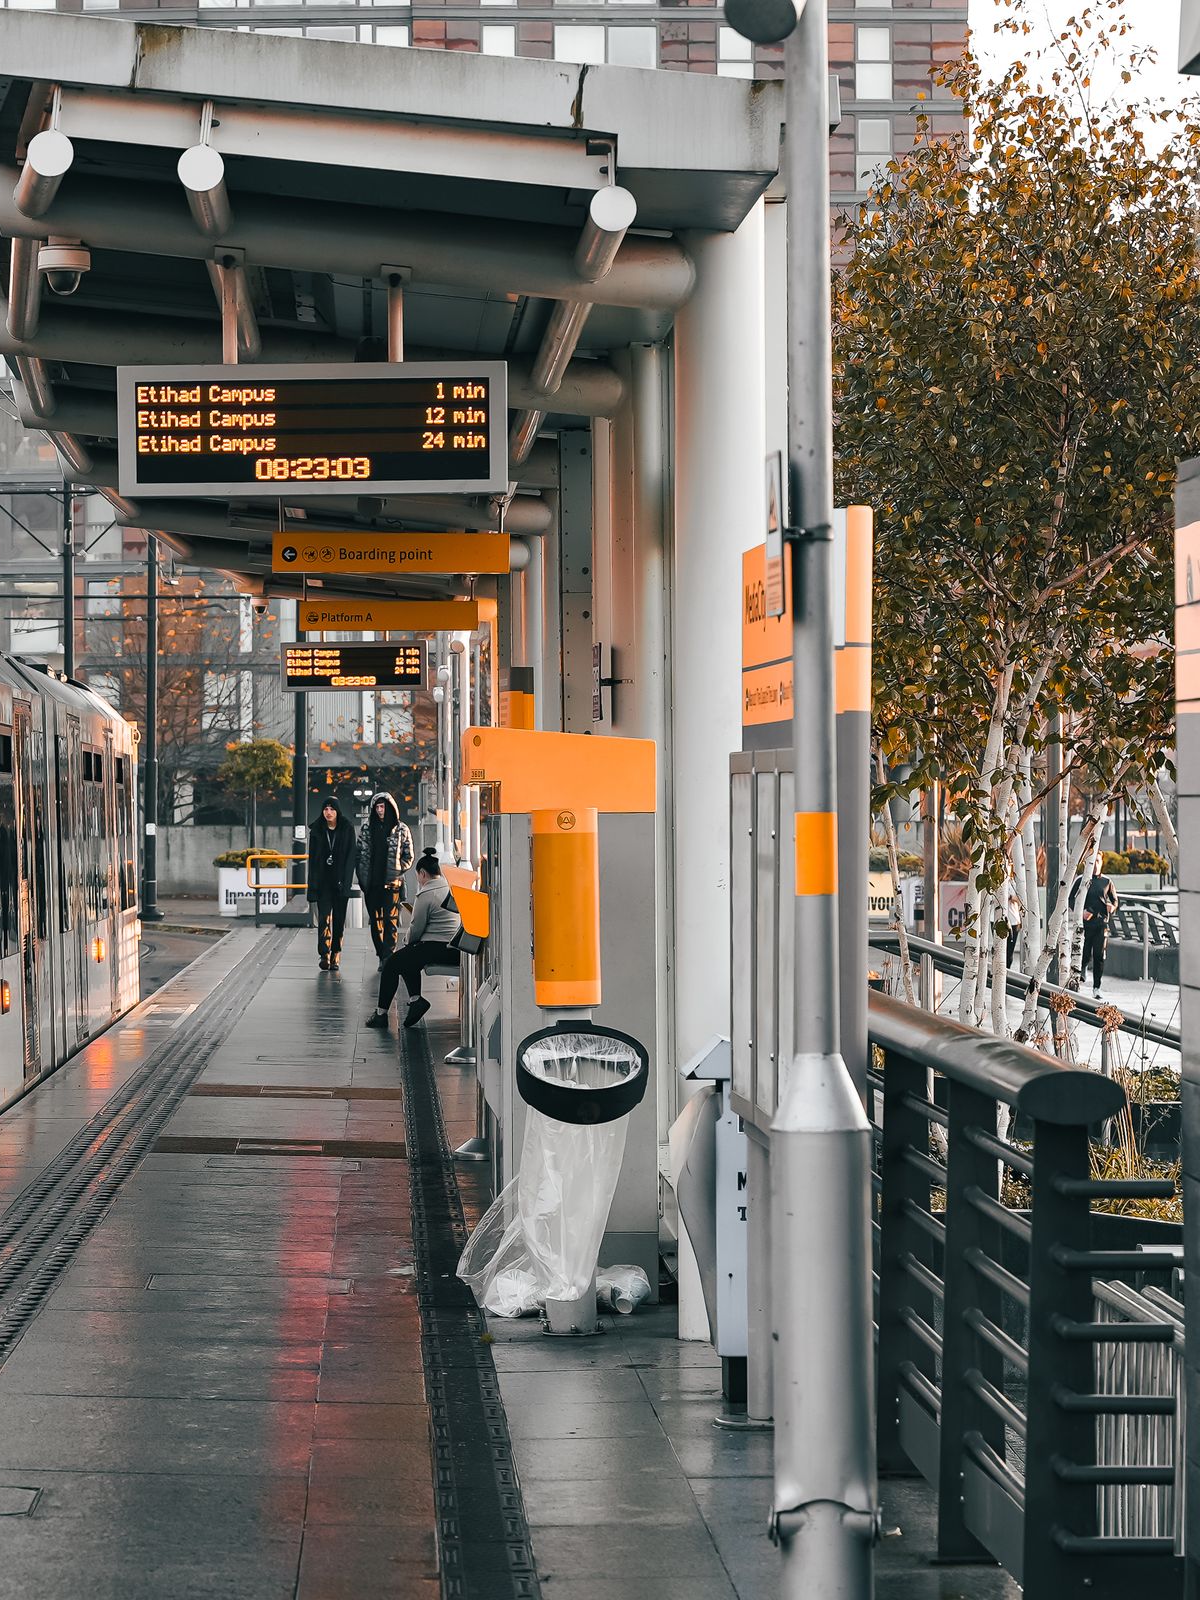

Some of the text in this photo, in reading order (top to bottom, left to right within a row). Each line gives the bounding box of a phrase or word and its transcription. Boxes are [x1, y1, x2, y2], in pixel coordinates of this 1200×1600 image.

[137, 381, 485, 405] Etihad Campus 1 min
[137, 406, 486, 430] Etihad Campus 12 min
[138, 431, 486, 455] Etihad Campus 24 min
[255, 457, 370, 480] 08:23:03
[339, 548, 433, 563] Boarding point
[321, 612, 373, 623] Platform A
